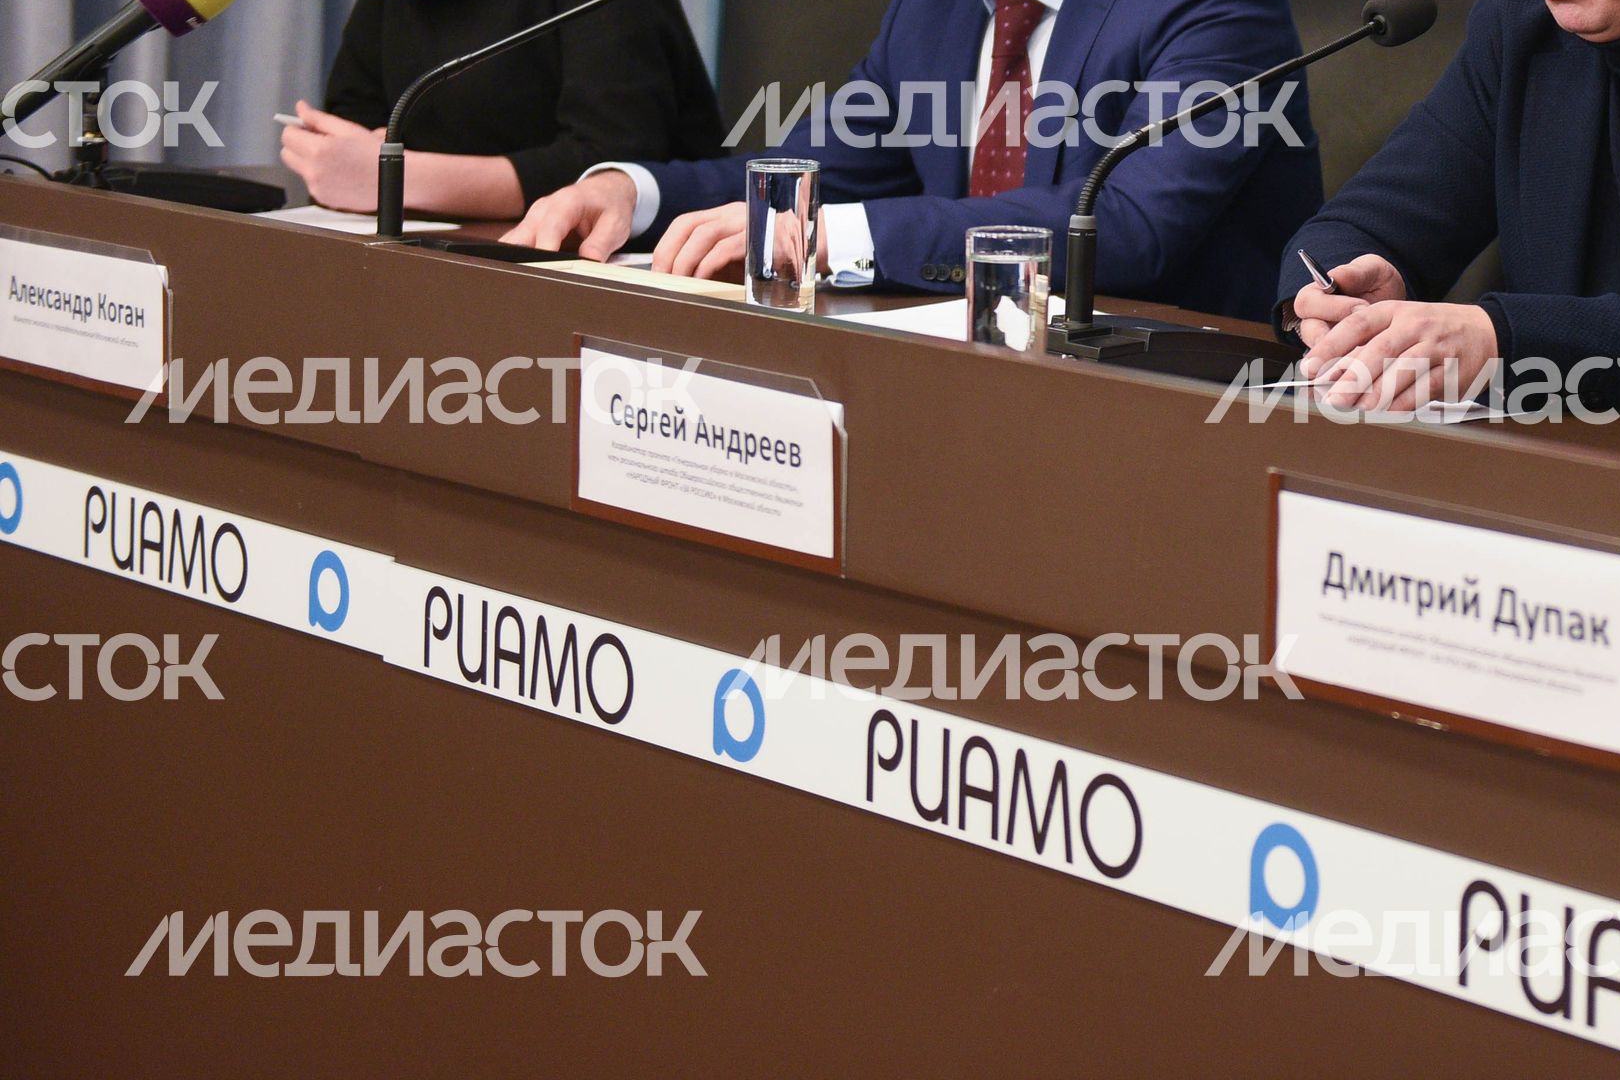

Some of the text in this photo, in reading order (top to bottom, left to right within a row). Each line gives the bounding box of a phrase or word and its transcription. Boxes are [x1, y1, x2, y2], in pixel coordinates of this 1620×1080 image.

[9, 275, 145, 329] Александр Коган
[610, 394, 687, 441] Сергей
[695, 414, 802, 467] Андреев
[84, 485, 248, 603] РИАМО
[1322, 552, 1610, 645] Дмитрий Дупак
[424, 586, 634, 725] РИАМО
[866, 709, 1143, 878] РИАМО
